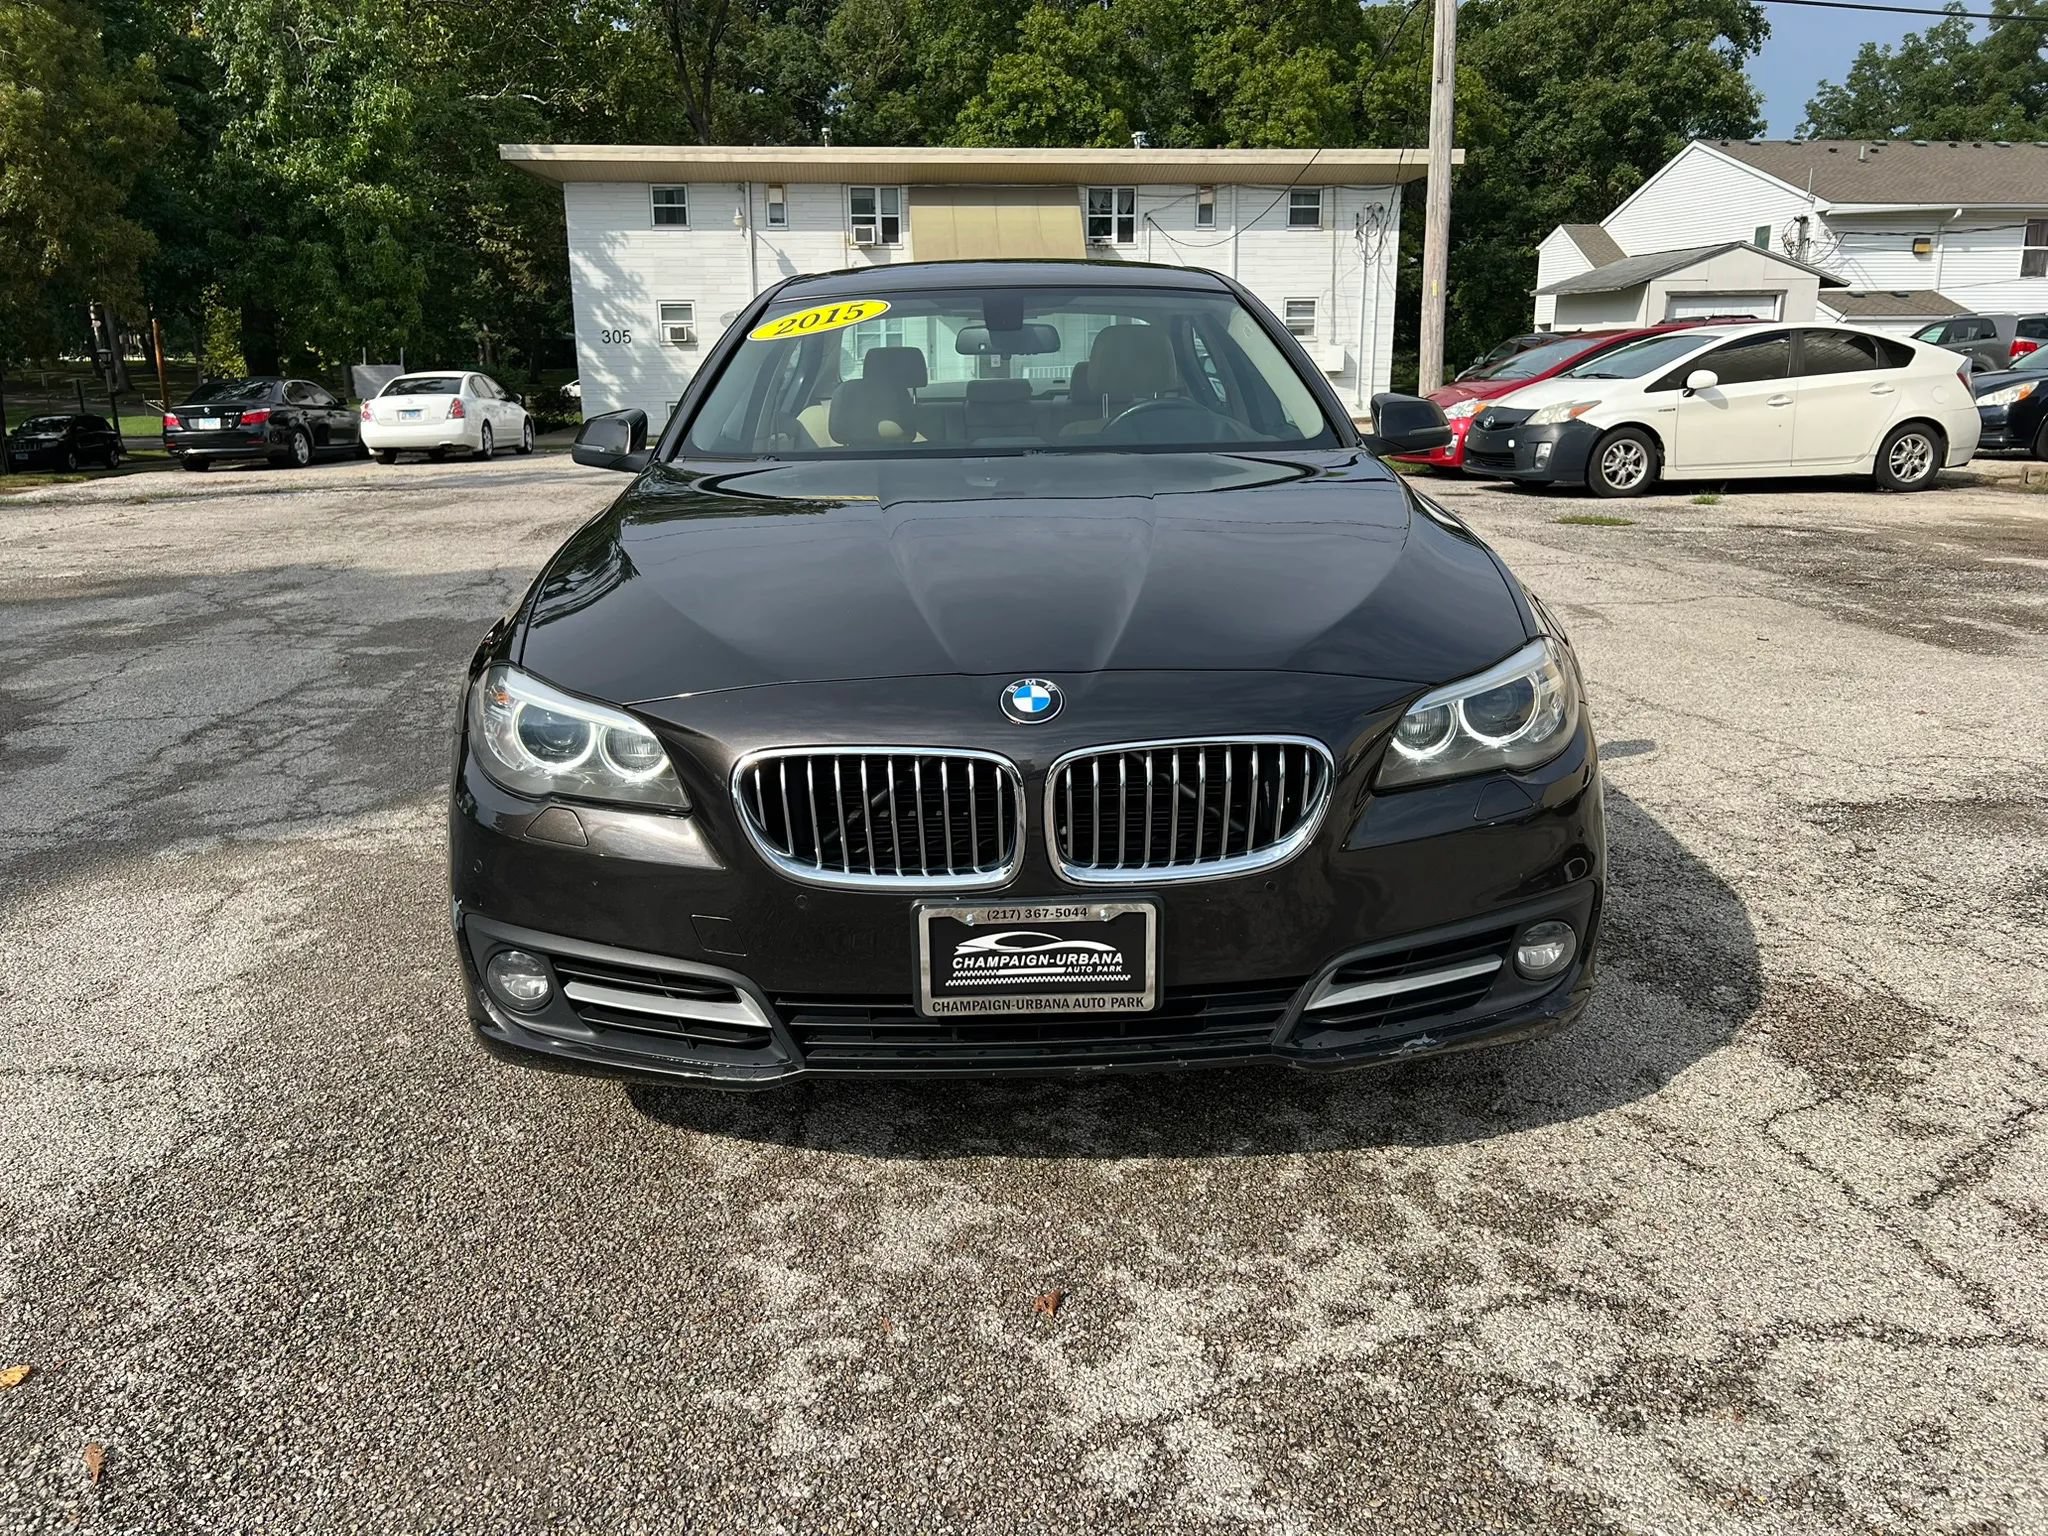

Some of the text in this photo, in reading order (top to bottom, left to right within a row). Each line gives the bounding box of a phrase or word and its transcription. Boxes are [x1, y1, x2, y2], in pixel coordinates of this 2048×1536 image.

[773, 303, 866, 336] 2015
[601, 329, 632, 344] 305
[1007, 679, 1057, 693] BMW
[987, 907, 1088, 921] (217) 367-5044
[952, 952, 1124, 969] CHAMPAIGN-URBANA
[1066, 965, 1123, 973] AUTO PARK
[932, 996, 1145, 1013] CHAMPAIGN-URBANA AUTO PARK
